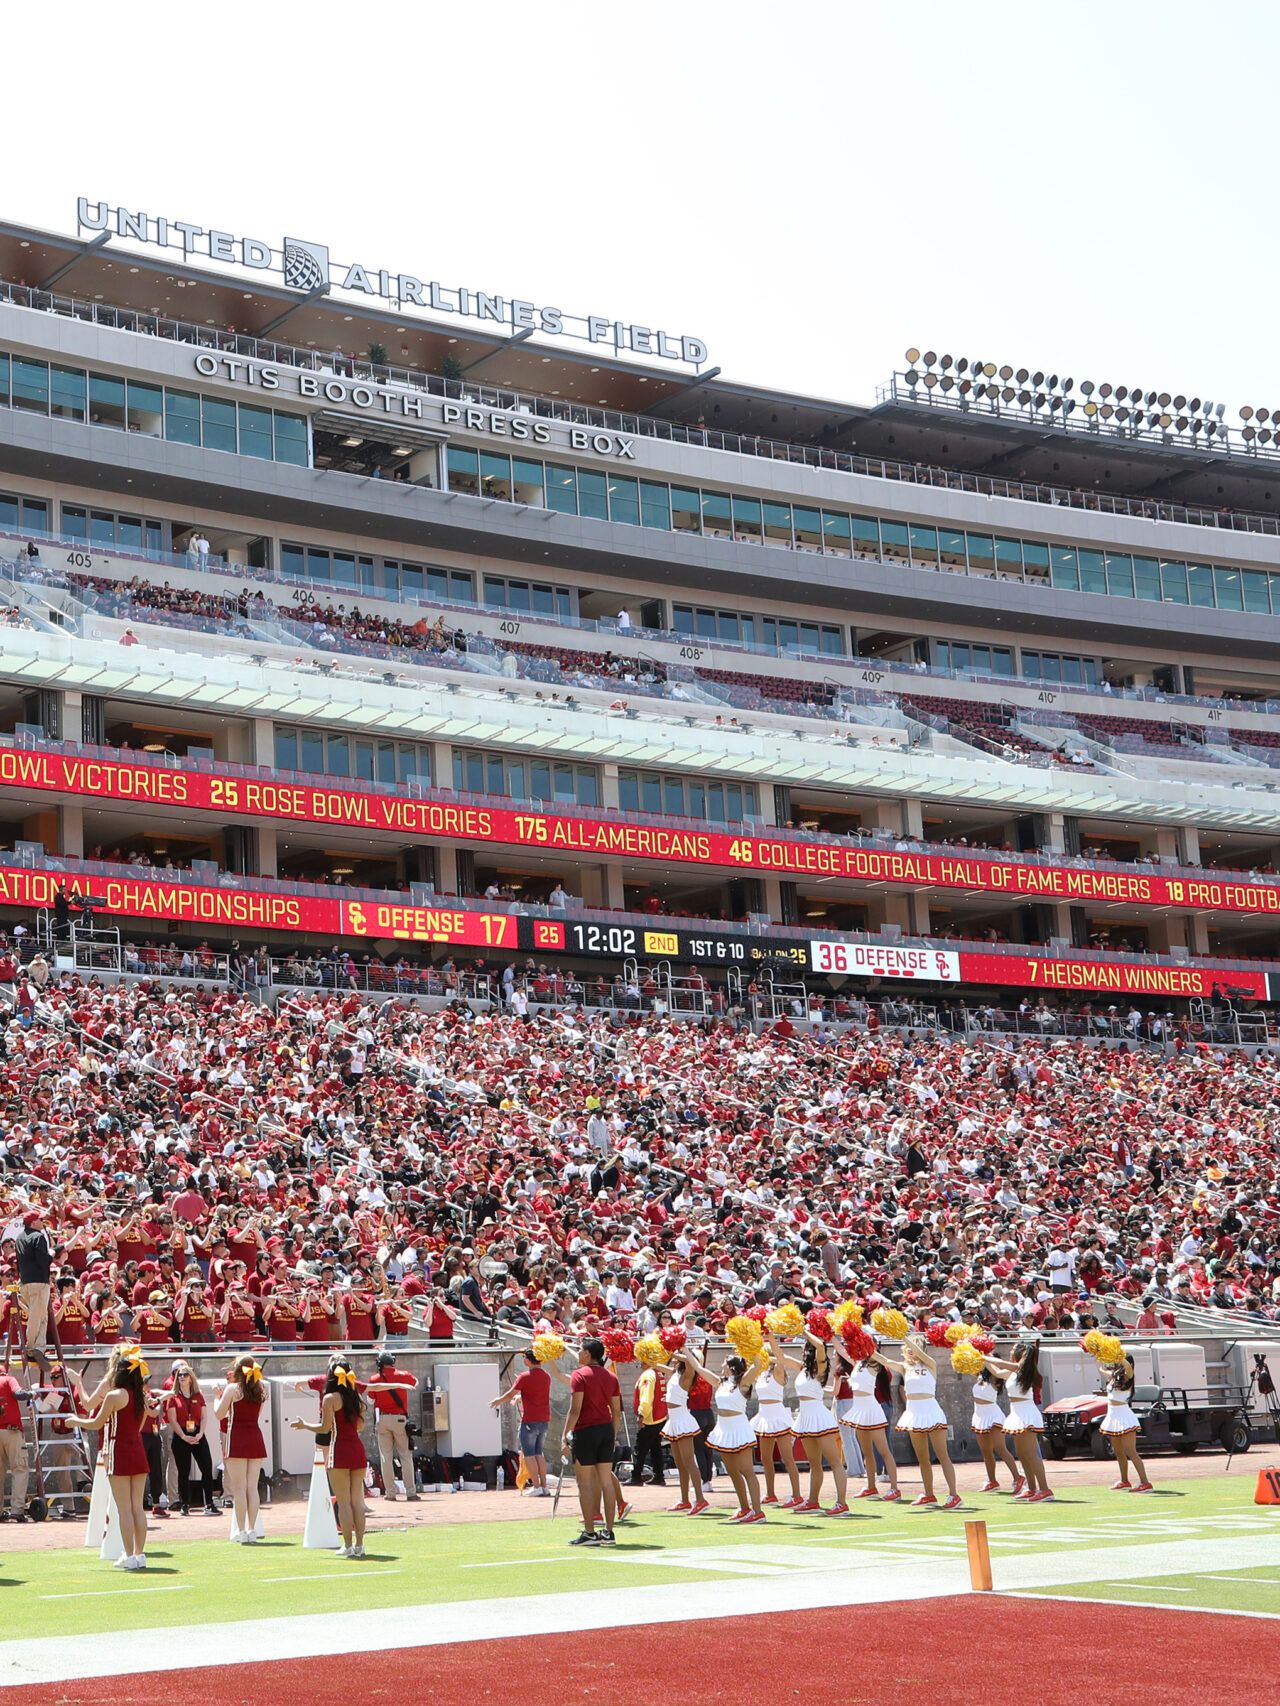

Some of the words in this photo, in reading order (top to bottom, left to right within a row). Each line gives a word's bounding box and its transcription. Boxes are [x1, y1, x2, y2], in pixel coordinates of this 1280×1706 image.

[77, 197, 272, 269] UNITED
[342, 264, 564, 336] AIRLINES
[588, 316, 708, 365] FIELD
[195, 353, 280, 390] OTIS
[300, 374, 423, 419] BOOTH
[443, 404, 551, 445] PRESS
[571, 429, 636, 460] BOX
[66, 552, 92, 569] 405
[292, 589, 315, 603] 406
[499, 621, 521, 635] 407
[679, 647, 700, 661] 408
[861, 671, 881, 683] 409
[1038, 691, 1057, 703] 410
[63, 761, 187, 800] VICTORIES
[210, 779, 238, 805] 25
[246, 785, 304, 815] ROSE
[313, 793, 376, 823] BOWL
[382, 801, 492, 835] VICTORIES
[515, 816, 547, 842] 175
[553, 822, 710, 859] ALL-AMERICANS
[729, 838, 753, 863] 46
[758, 842, 842, 873] COLLEGE
[846, 852, 937, 884] FOOTBALL
[940, 861, 987, 887] HALL
[990, 866, 1012, 888] OF
[1017, 868, 1064, 893] FAME
[1067, 872, 1150, 900] MEMBERS
[1165, 881, 1184, 902] 18
[1188, 883, 1222, 905] PRO
[1225, 886, 1280, 909] FOOTB
[107, 883, 300, 926] CHAMPIONSHIPS
[378, 907, 465, 934] OFFENSE
[480, 915, 507, 945] 17
[539, 925, 558, 944] 25
[573, 926, 636, 954] 12:02
[649, 935, 676, 953] 2ND
[689, 940, 713, 957] 1ST
[716, 941, 726, 958] &
[729, 943, 744, 959] 10
[790, 948, 806, 964] 25
[819, 944, 847, 972] 36
[855, 948, 927, 970] DEFENSE
[1027, 961, 1038, 983] 7
[1043, 965, 1121, 989] HEISMAN
[1124, 968, 1203, 993] WINNERS
[852, 1510, 1280, 1550] ITRUS
